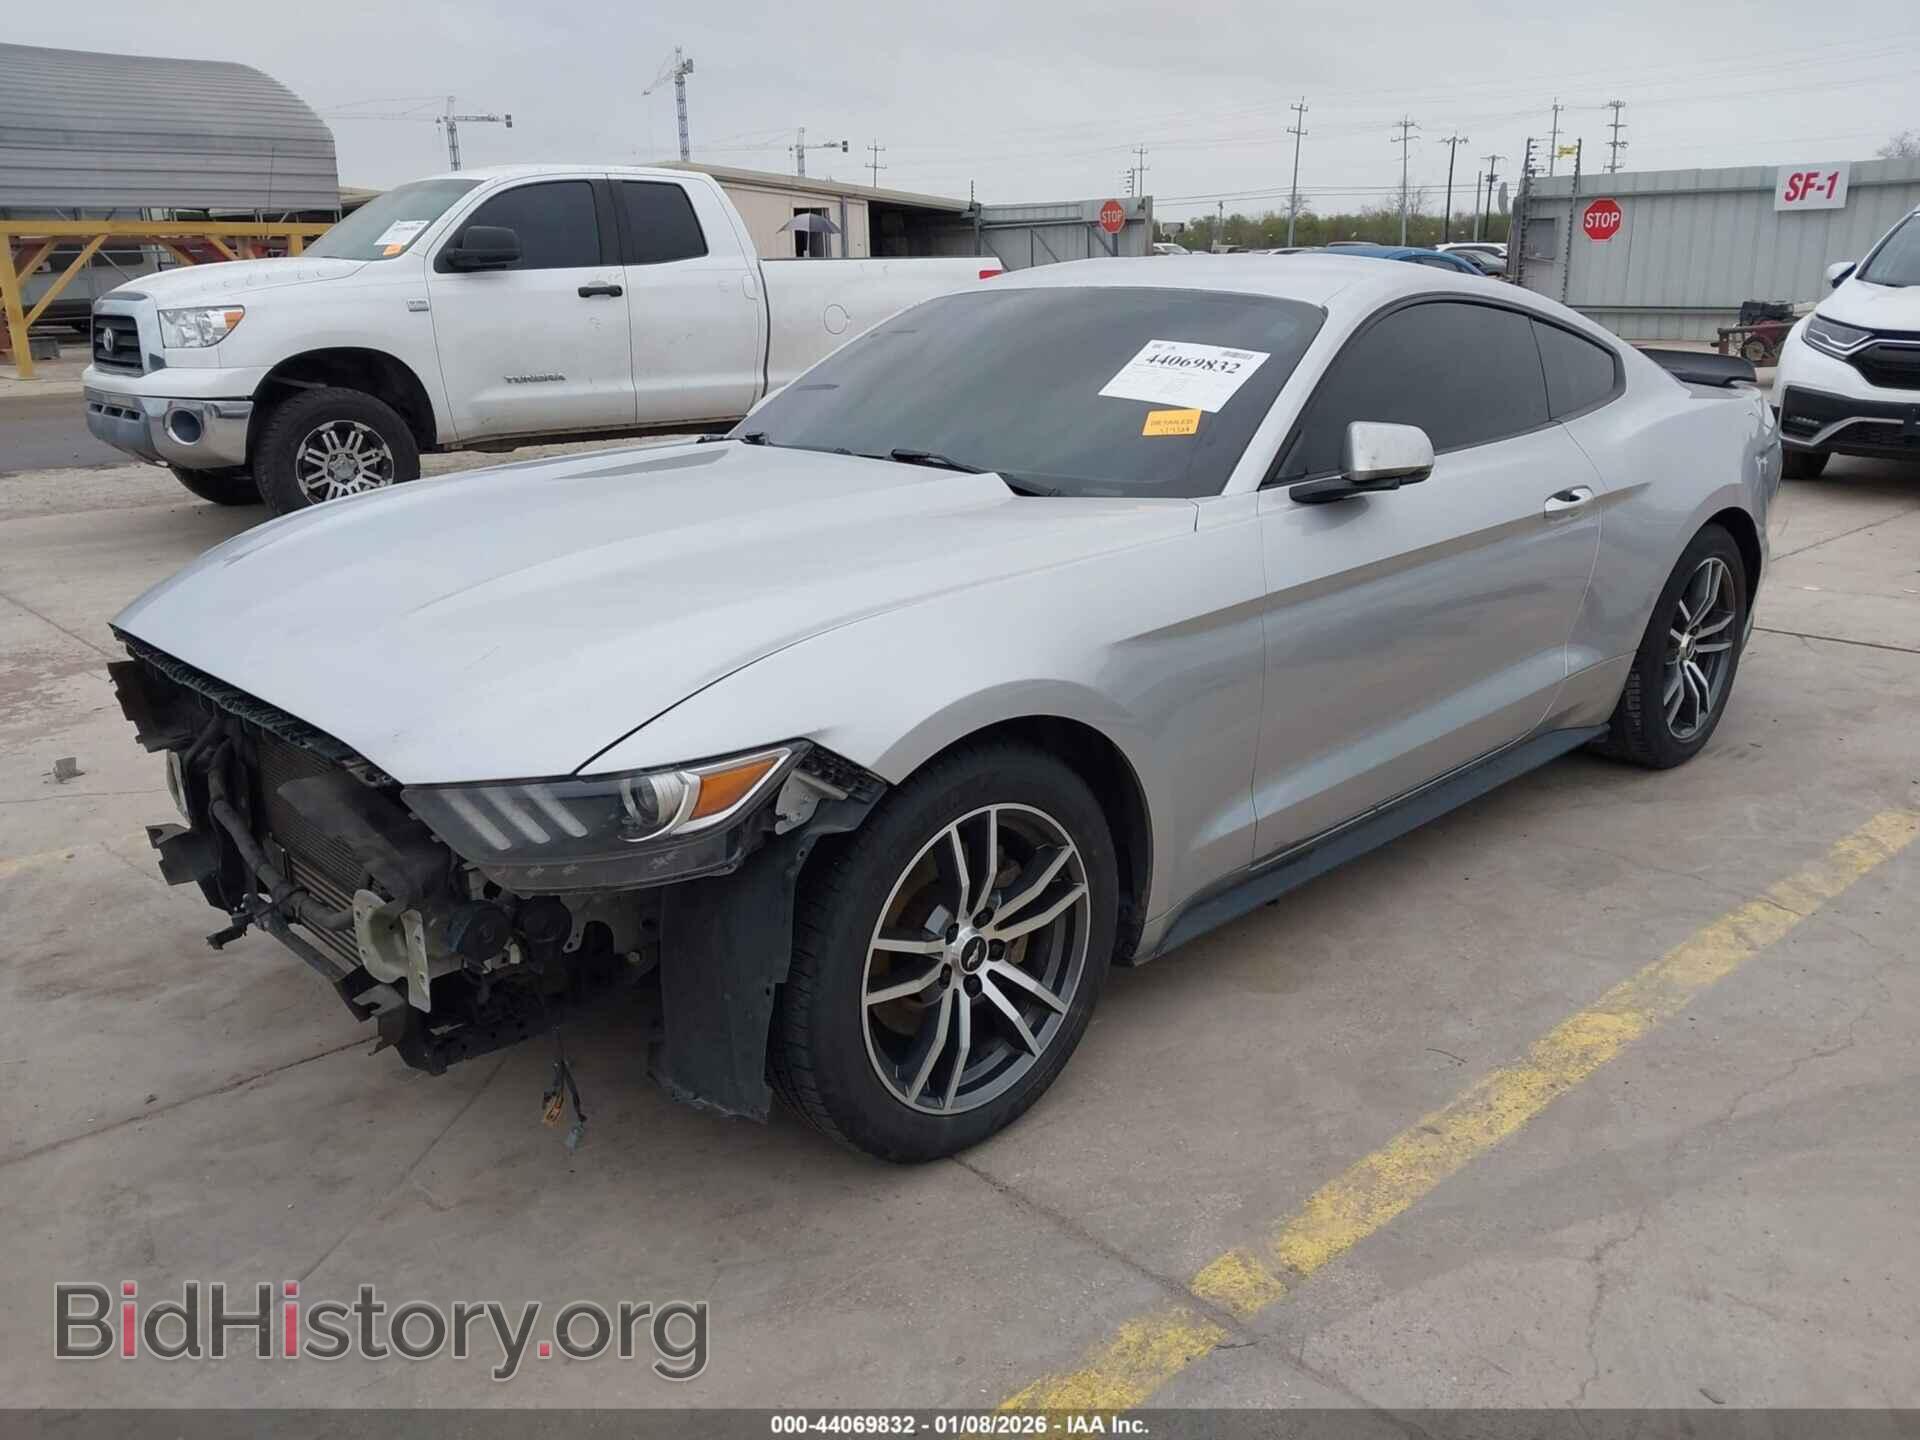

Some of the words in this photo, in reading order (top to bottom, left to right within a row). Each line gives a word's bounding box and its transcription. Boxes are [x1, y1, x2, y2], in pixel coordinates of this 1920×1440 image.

[1784, 171, 1839, 202] SF-1
[1101, 210, 1122, 224] STOP
[1585, 212, 1620, 228] STOP
[1145, 354, 1241, 374] 44069832
